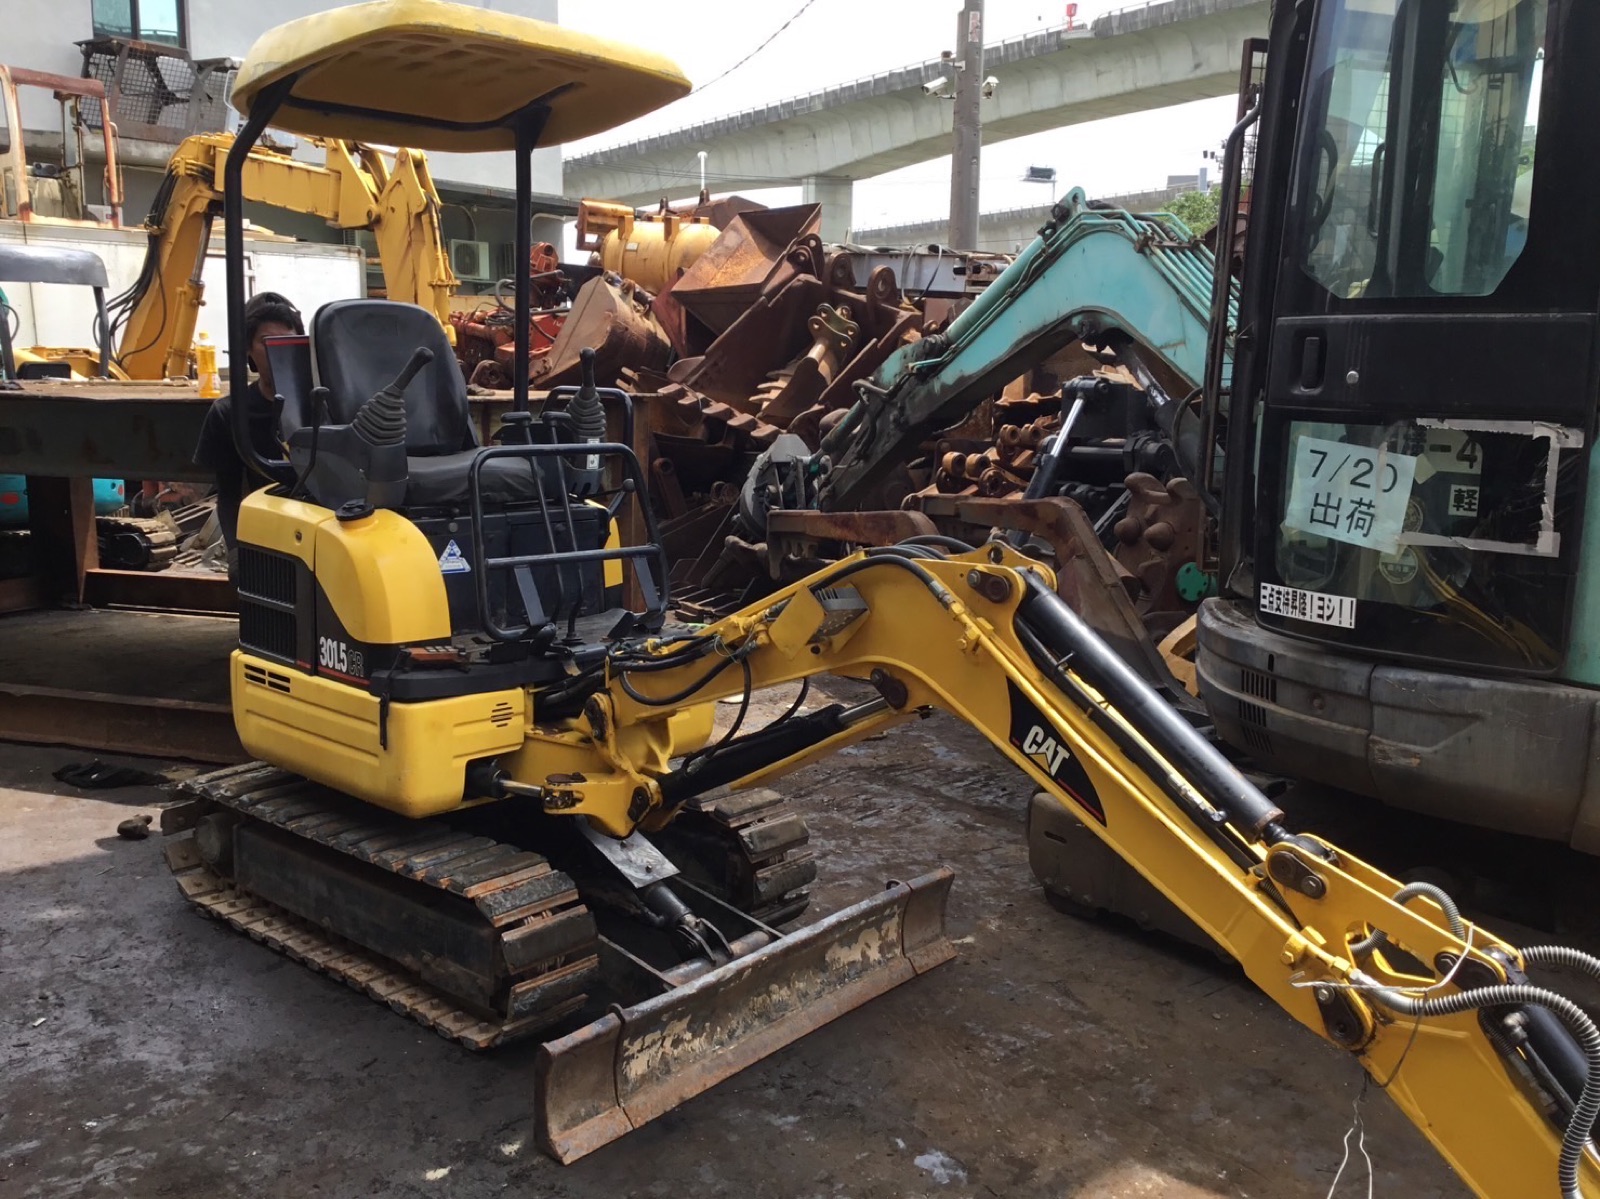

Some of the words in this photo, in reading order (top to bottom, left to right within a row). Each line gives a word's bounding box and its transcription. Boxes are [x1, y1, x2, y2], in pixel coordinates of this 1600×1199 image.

[1309, 492, 1376, 538] 出荷
[1452, 488, 1478, 512] 軽
[347, 649, 364, 678] CR
[1022, 725, 1070, 777] CAT
